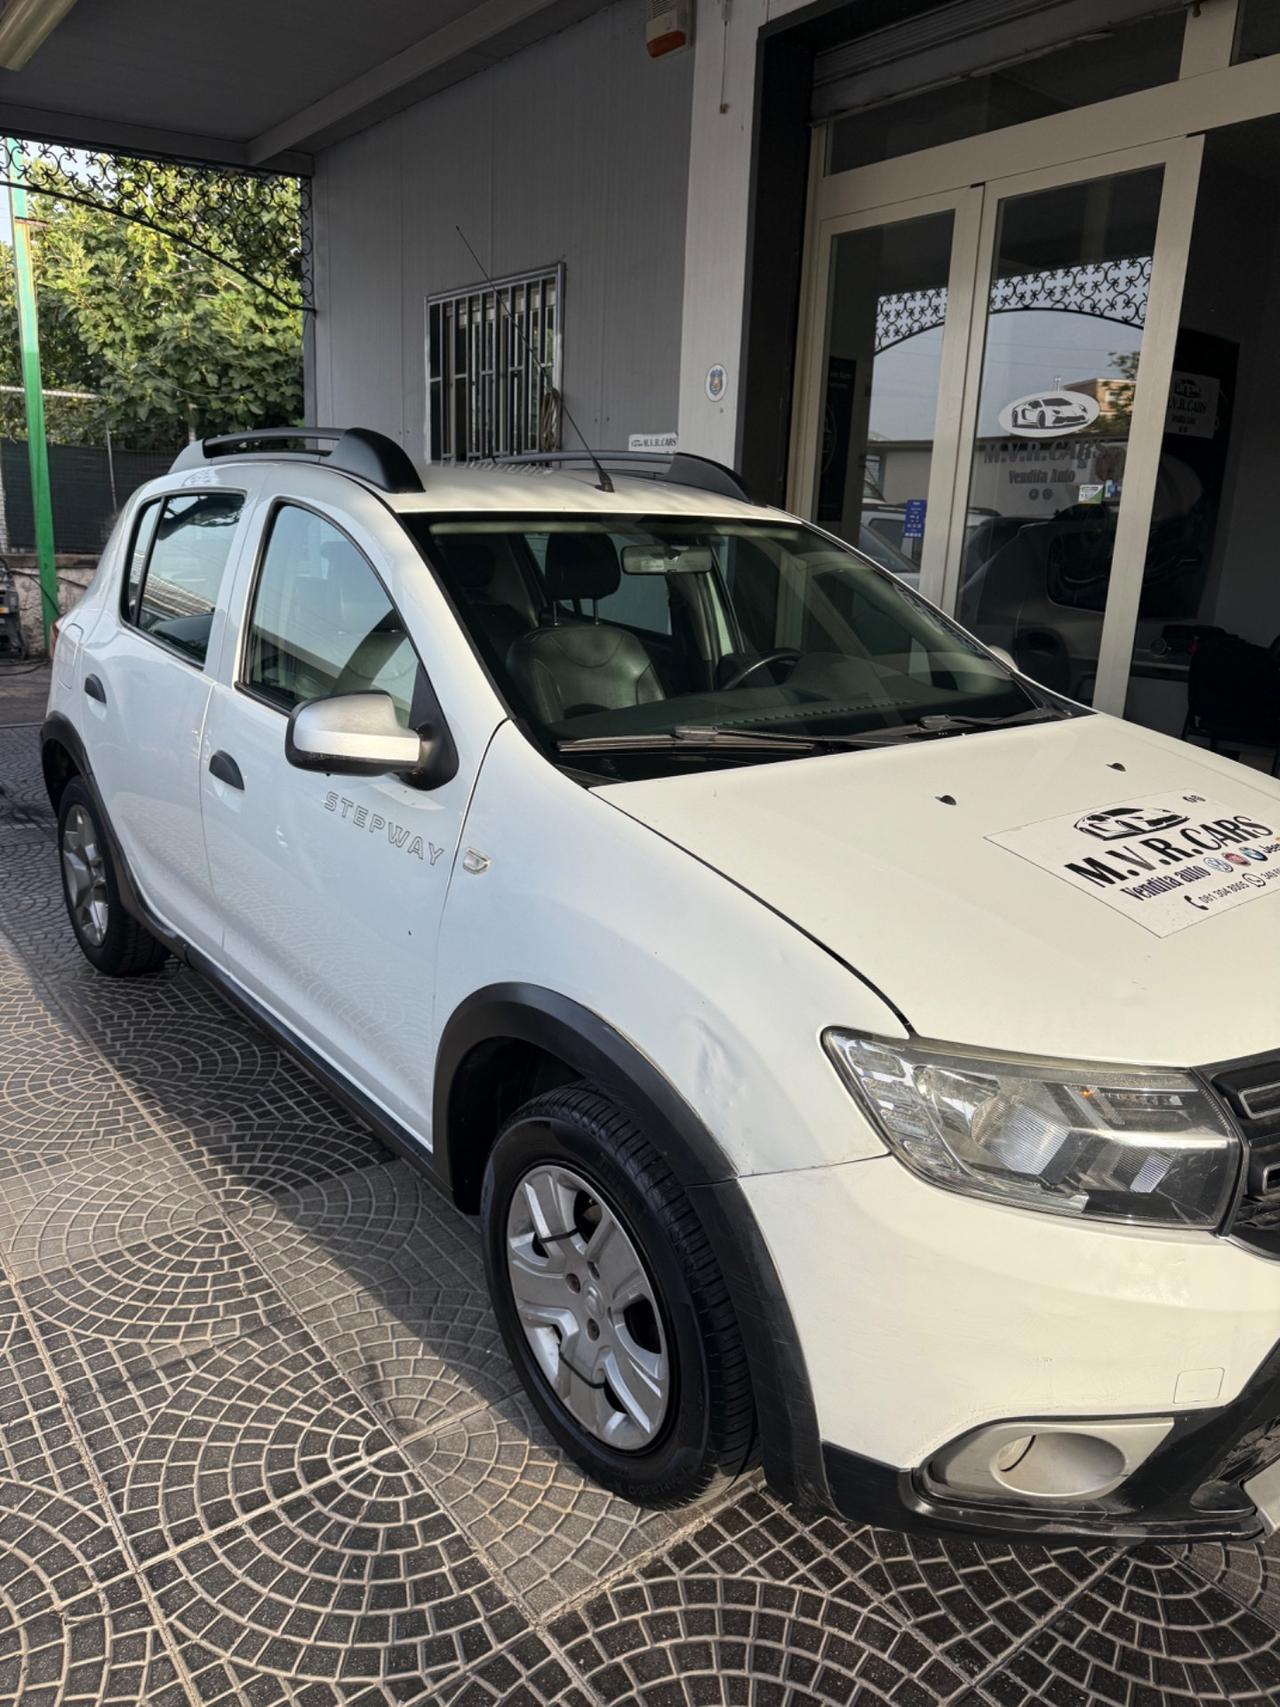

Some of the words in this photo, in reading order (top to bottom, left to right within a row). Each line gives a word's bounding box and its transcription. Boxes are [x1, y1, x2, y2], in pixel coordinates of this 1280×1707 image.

[1009, 469, 1048, 484] Vendita
[1050, 468, 1075, 483] Auto
[324, 791, 445, 866] STEPWAY
[1064, 815, 1274, 888] M.V.R.CARS
[1120, 874, 1184, 901] Vendita
[1174, 865, 1212, 883] auto
